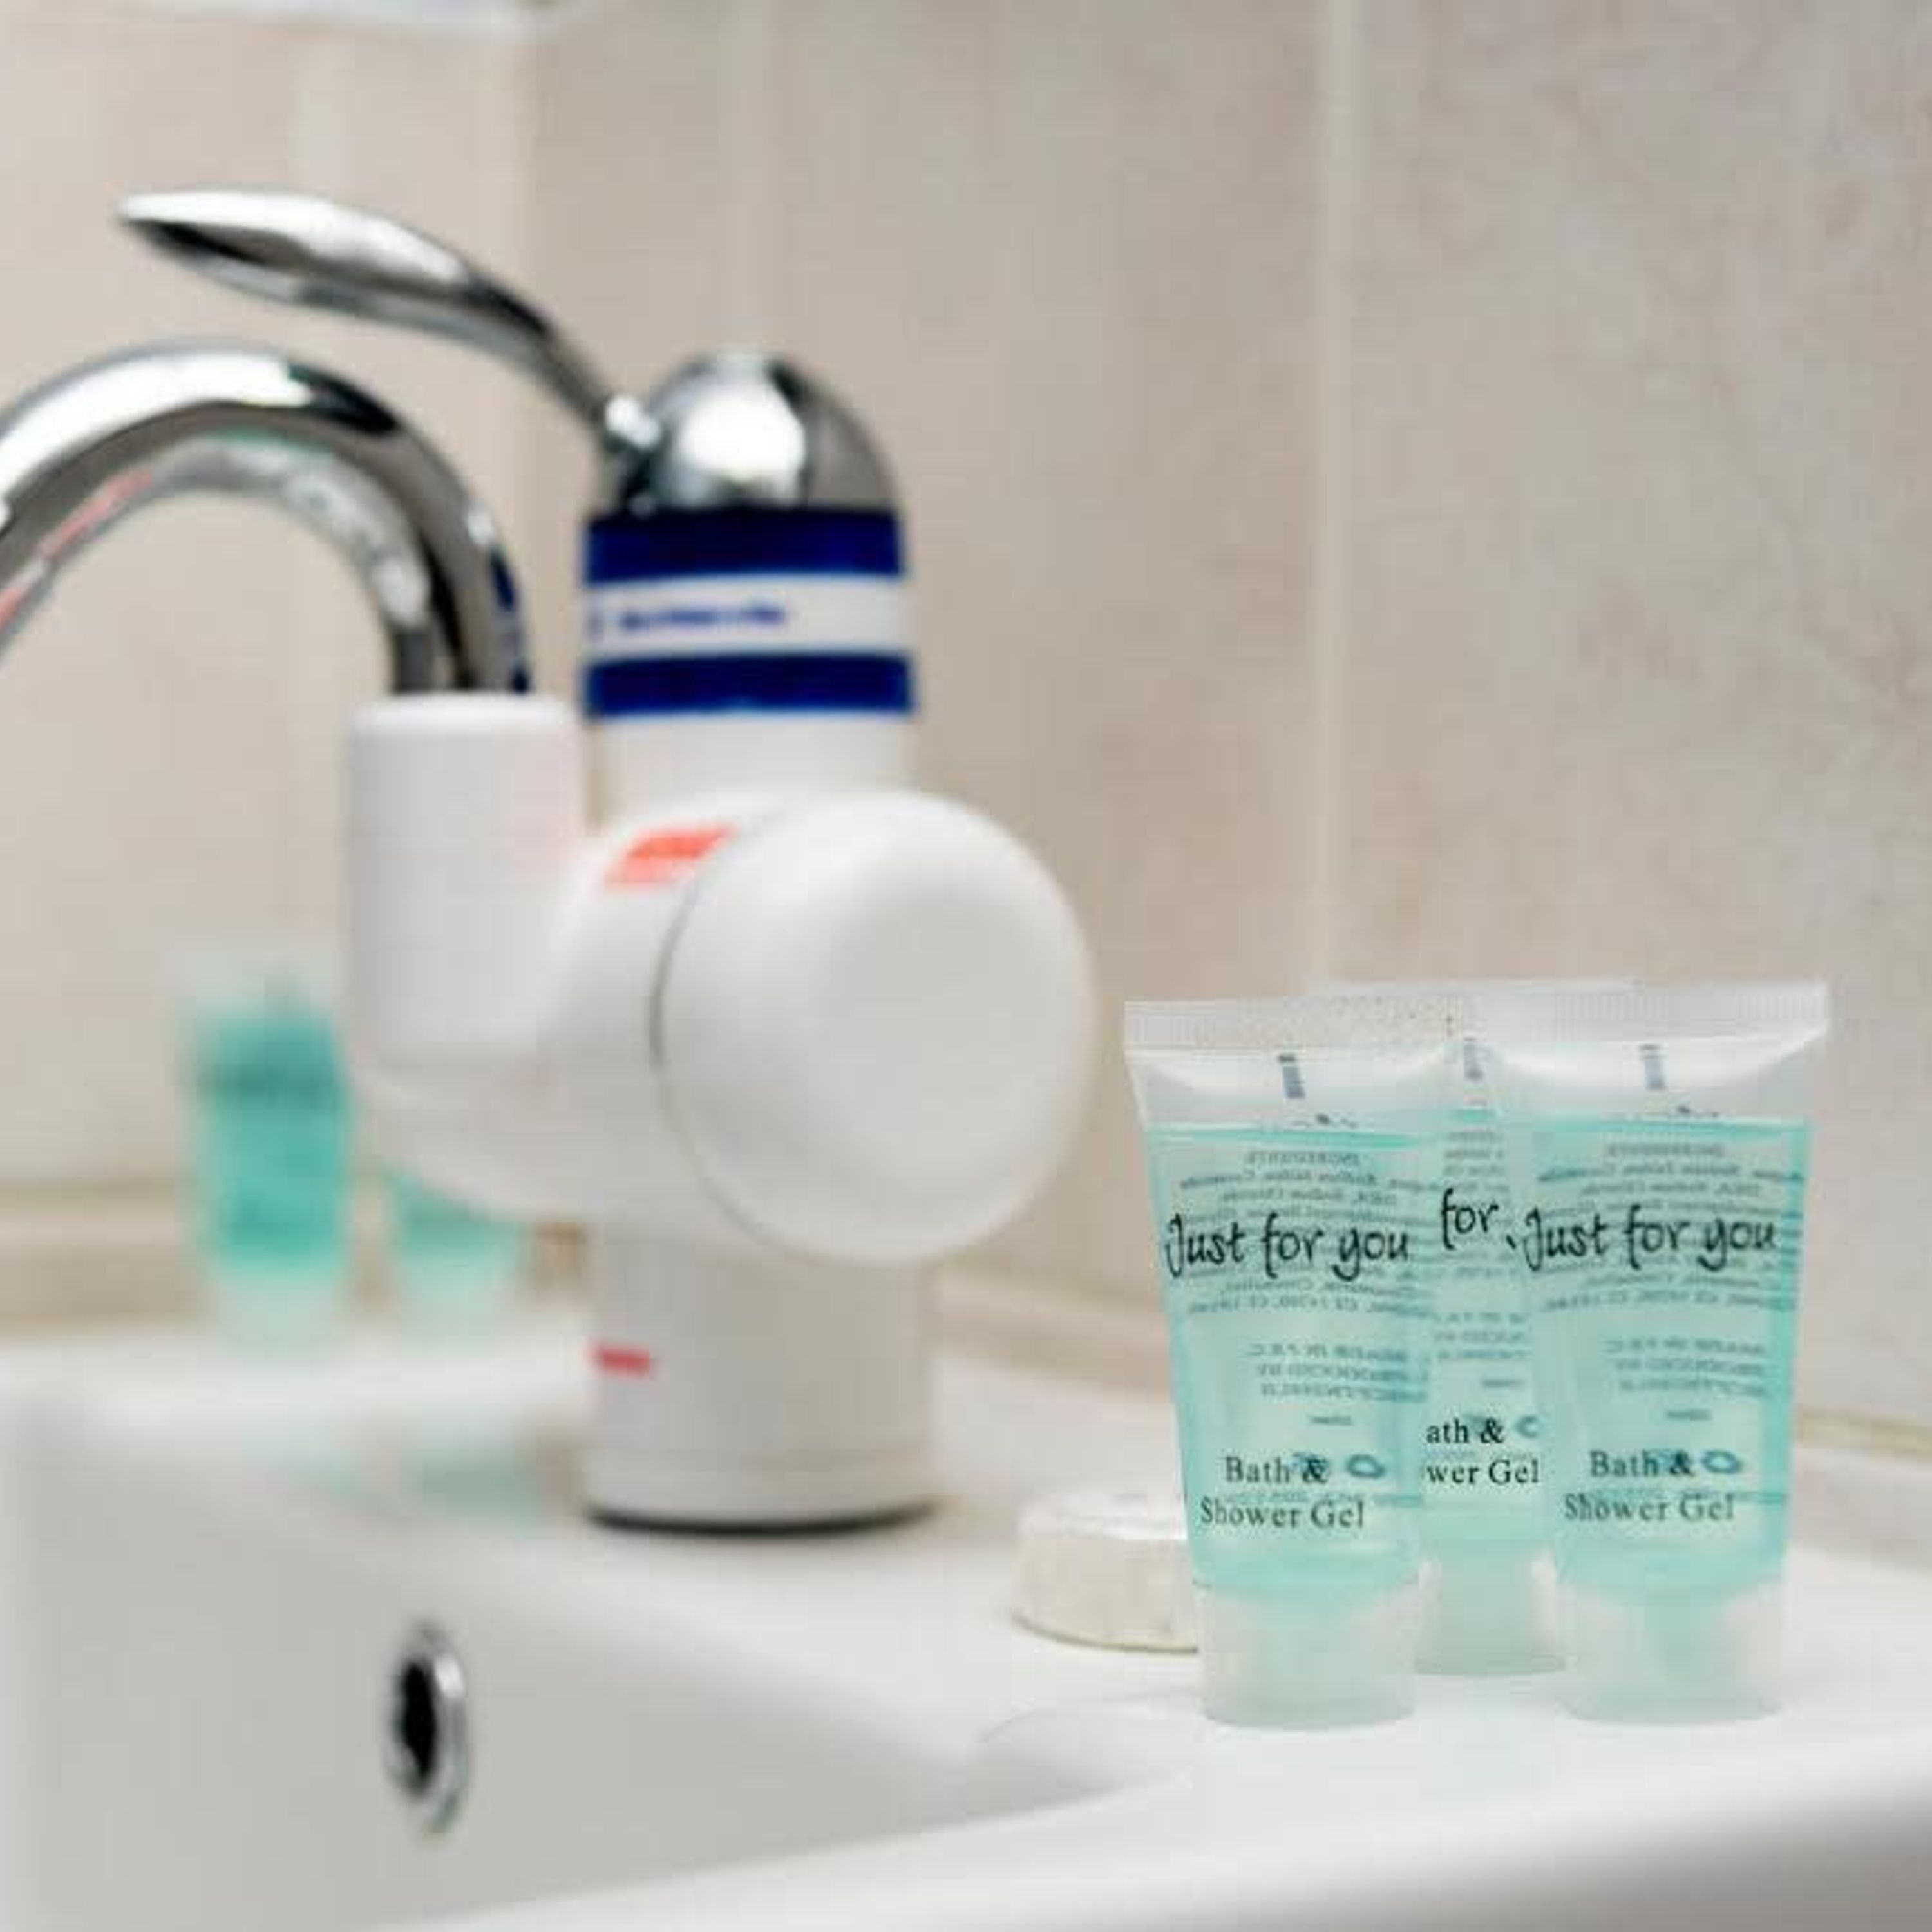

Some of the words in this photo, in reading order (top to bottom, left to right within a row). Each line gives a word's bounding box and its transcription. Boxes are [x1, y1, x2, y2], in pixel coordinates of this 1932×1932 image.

[1441, 1187, 1499, 1250] for
[1164, 1213, 1245, 1278] Just
[1260, 1212, 1324, 1279] for
[1332, 1228, 1410, 1280] you
[1522, 1206, 1609, 1271] Just
[1624, 1204, 1690, 1271] for
[1697, 1217, 1779, 1271] you
[1426, 1417, 1470, 1444] ath
[1479, 1417, 1505, 1444] &
[1224, 1455, 1290, 1484] Bath
[1301, 1457, 1330, 1484] &
[1426, 1464, 1479, 1484] wer
[1488, 1458, 1539, 1486] Gel
[1589, 1449, 1659, 1479] Bath
[1669, 1450, 1695, 1477] &
[1200, 1495, 1300, 1529] Shower
[1310, 1498, 1365, 1529] Gel
[1564, 1492, 1668, 1522] Shower
[1678, 1492, 1735, 1522] Gel
